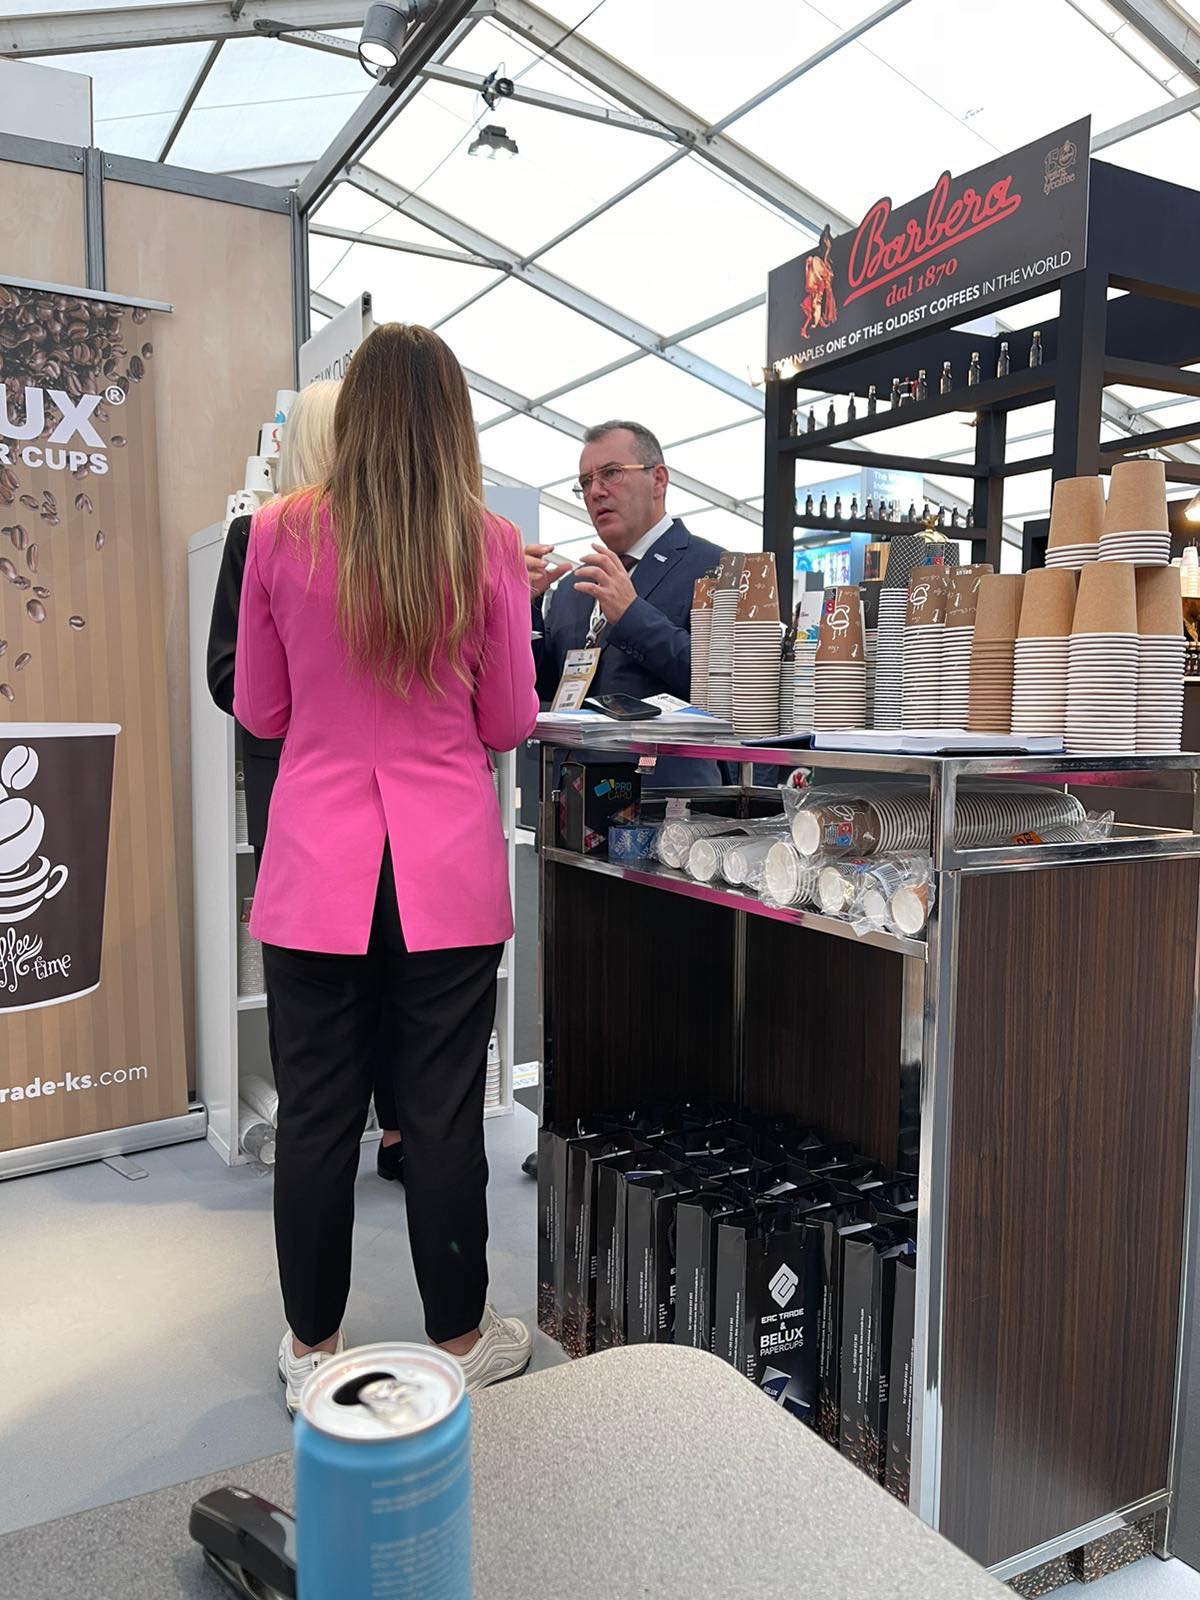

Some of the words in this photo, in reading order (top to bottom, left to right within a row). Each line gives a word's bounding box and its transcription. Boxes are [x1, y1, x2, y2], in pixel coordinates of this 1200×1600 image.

[847, 175, 1021, 288] Barbera
[885, 277, 913, 307] dal
[916, 258, 958, 292] 1870
[794, 344, 825, 364] NAPLES
[825, 336, 847, 354] ONE
[848, 330, 862, 345] OF
[862, 322, 884, 340] THE
[885, 305, 928, 332] OLDEST
[929, 285, 980, 315] COFFEES
[982, 278, 996, 296] IN
[996, 269, 1020, 290] THE
[1021, 250, 1072, 280] WORLD
[21, 446, 109, 475] CUPS
[31, 954, 72, 980] time
[760, 1326, 804, 1348] BELUX
[780, 1321, 787, 1331] &
[760, 1340, 804, 1357] PAPERCUPS
